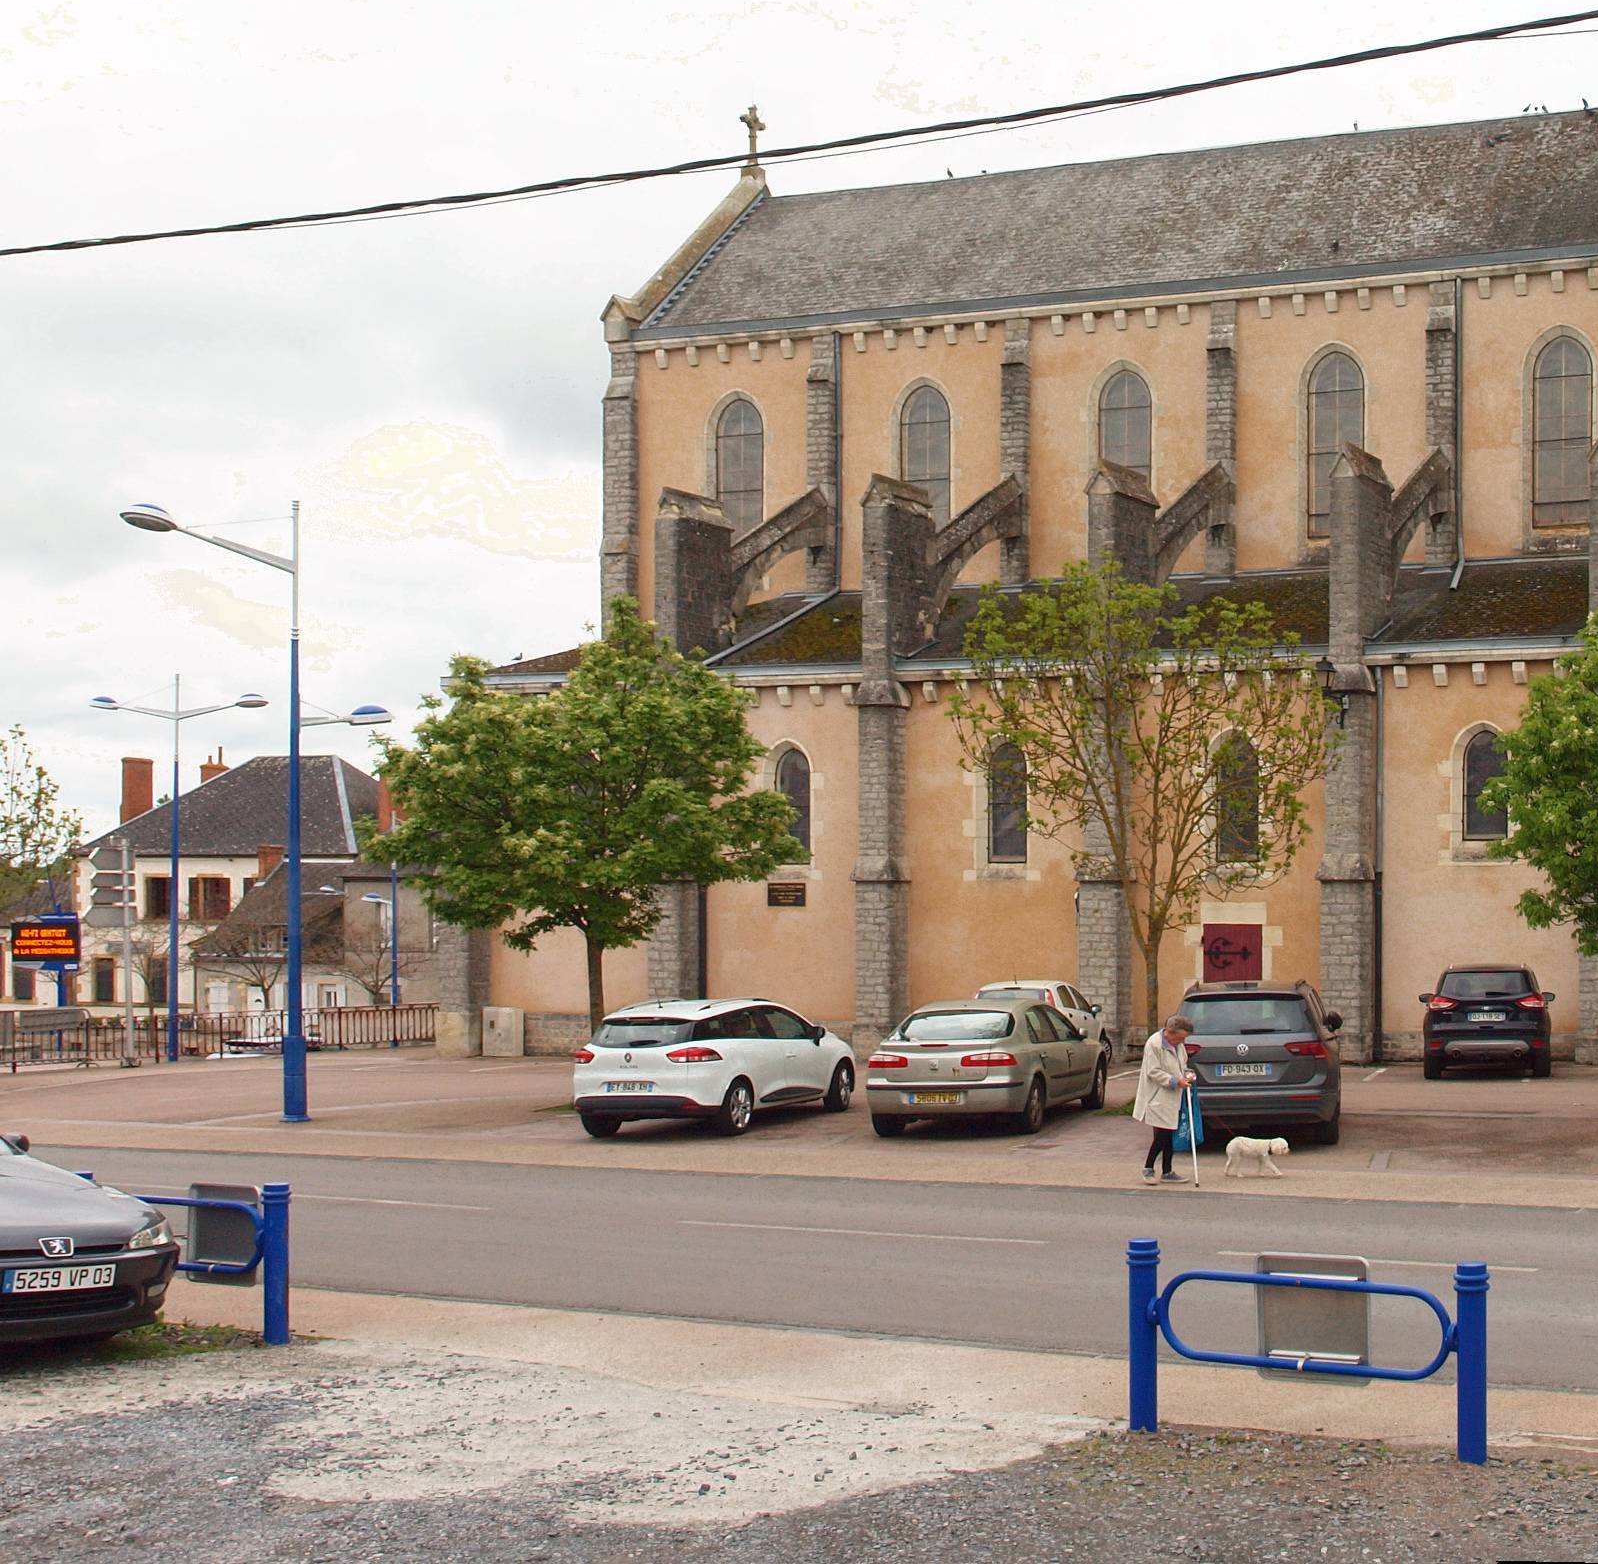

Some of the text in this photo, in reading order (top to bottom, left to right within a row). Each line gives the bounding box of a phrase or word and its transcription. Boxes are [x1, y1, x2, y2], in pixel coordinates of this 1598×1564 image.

[15, 1267, 113, 1290] 5259 VP 03
